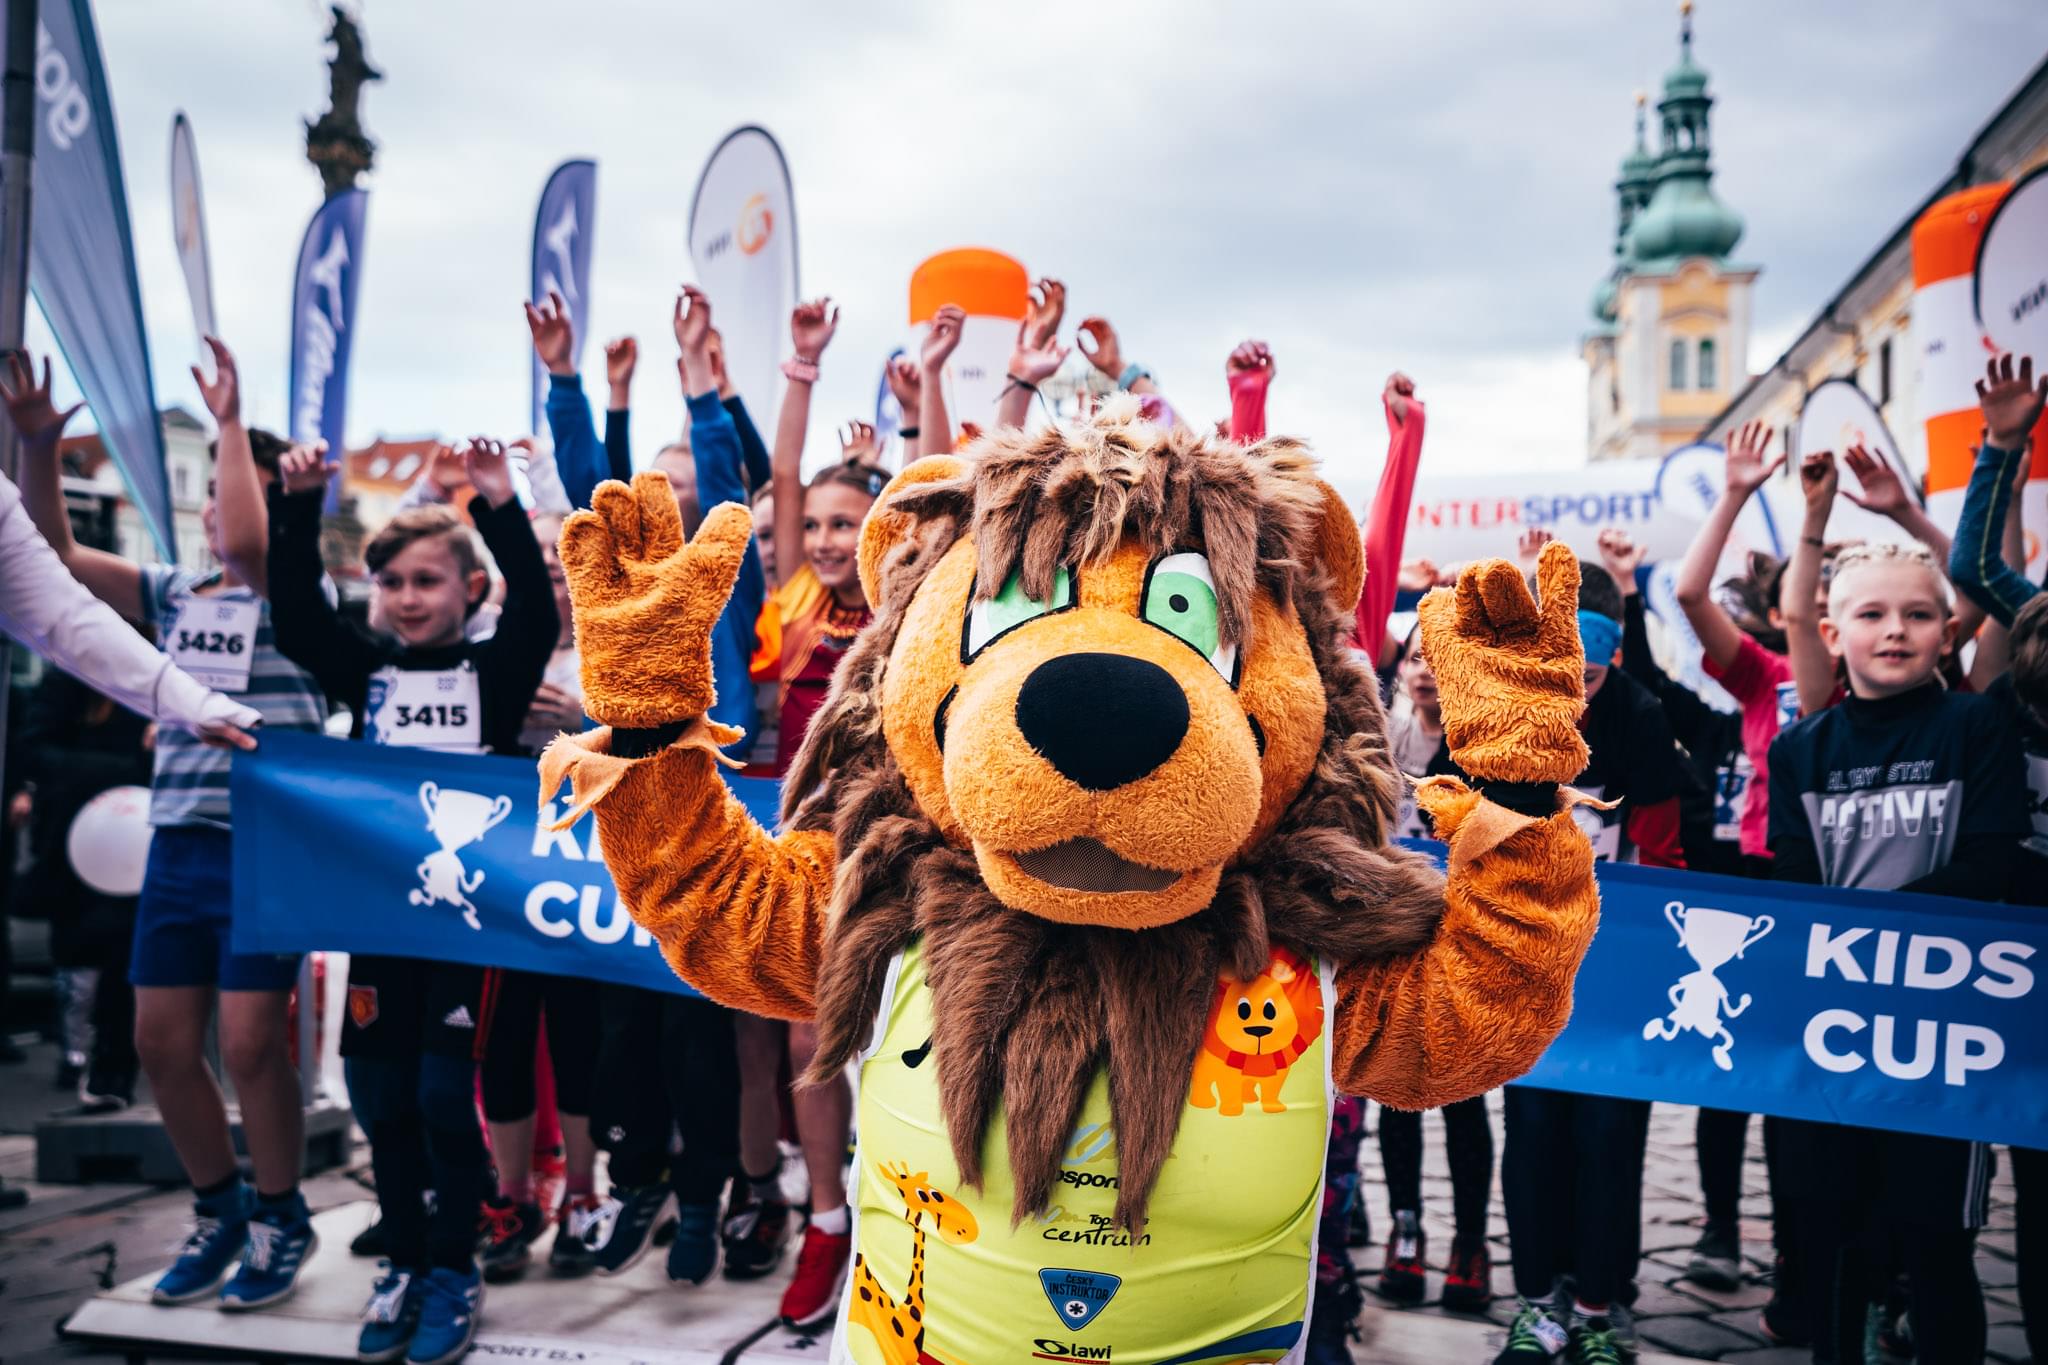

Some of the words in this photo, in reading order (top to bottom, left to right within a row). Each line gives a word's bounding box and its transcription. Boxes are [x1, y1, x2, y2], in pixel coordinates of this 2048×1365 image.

[1416, 493, 1653, 528] NTERSPORT
[178, 630, 244, 654] 3426
[396, 705, 468, 727] 3415
[1887, 759, 1935, 784] STAY
[525, 881, 652, 946] CU
[1805, 922, 2037, 999] KIDS
[1803, 1009, 2005, 1087] CUP
[1049, 1282, 1110, 1300] INSTRUKTOR
[1071, 1343, 1112, 1359] lawi
